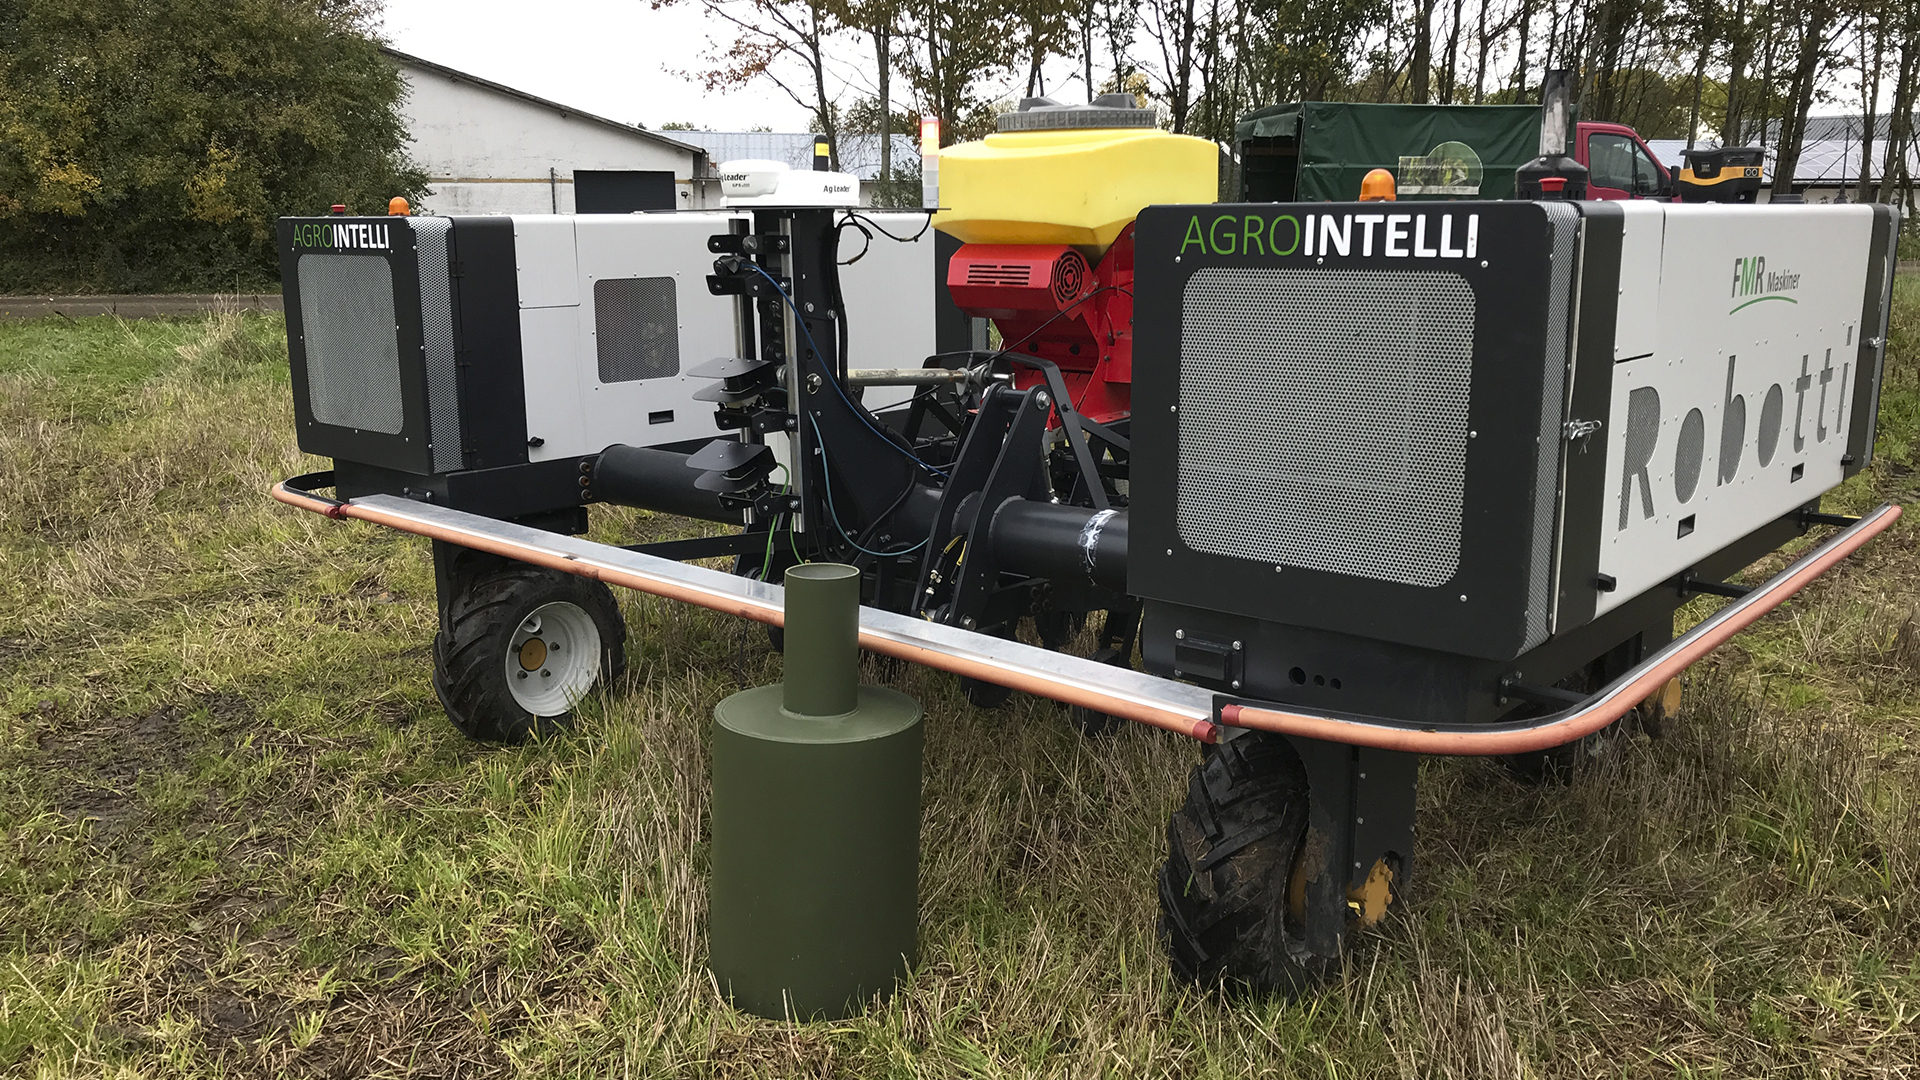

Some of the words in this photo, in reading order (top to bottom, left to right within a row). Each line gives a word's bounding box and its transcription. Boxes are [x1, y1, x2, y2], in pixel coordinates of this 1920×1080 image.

[823, 185, 833, 194] Ag
[834, 185, 851, 193] Leader
[293, 224, 390, 249] AGROINTELLI
[1180, 214, 1479, 259] AGROINTELLI
[1731, 256, 1766, 298] FMR
[1766, 269, 1801, 293] Maskiner
[1618, 325, 1853, 532] Robotti
